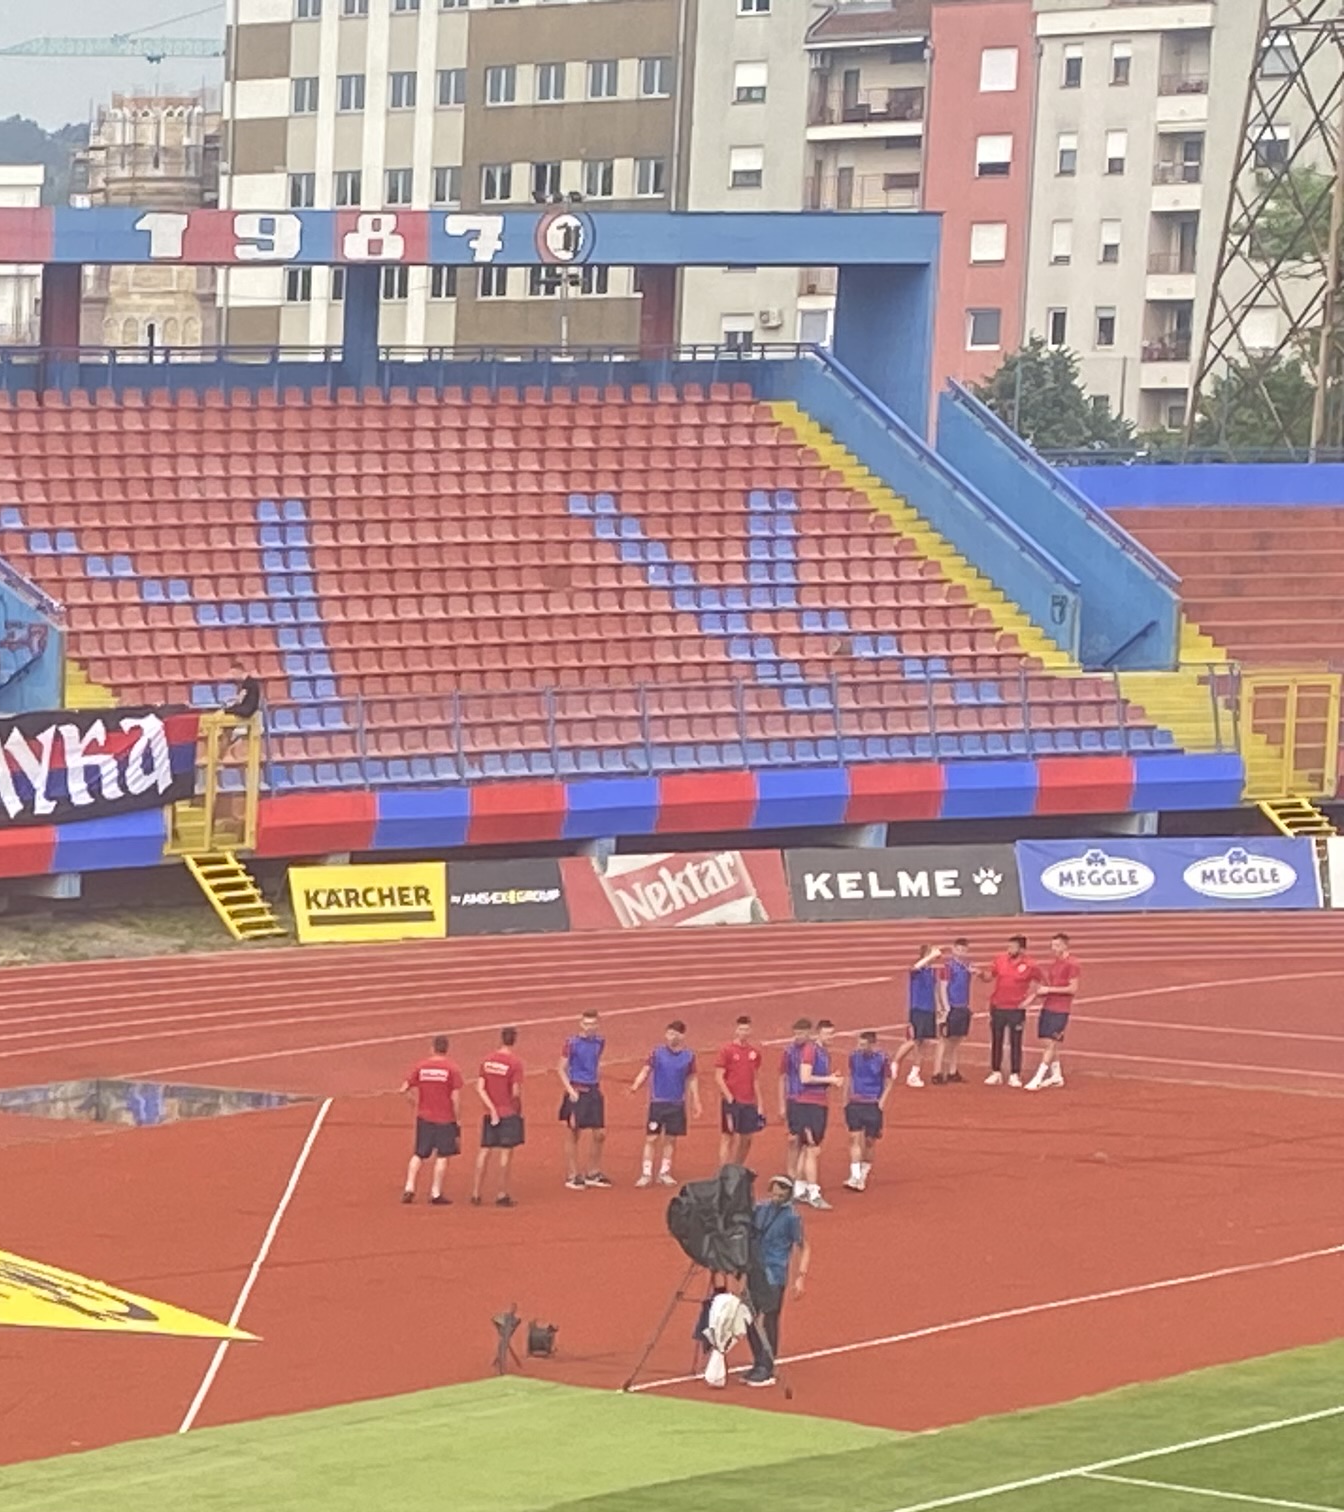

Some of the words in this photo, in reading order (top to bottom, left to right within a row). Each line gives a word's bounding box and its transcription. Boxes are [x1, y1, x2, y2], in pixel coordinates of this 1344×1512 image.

[804, 869, 961, 900] KELME
[1058, 867, 1139, 888] MEGGLE
[1201, 865, 1280, 886] MEGGLE
[616, 851, 740, 927] Nektar
